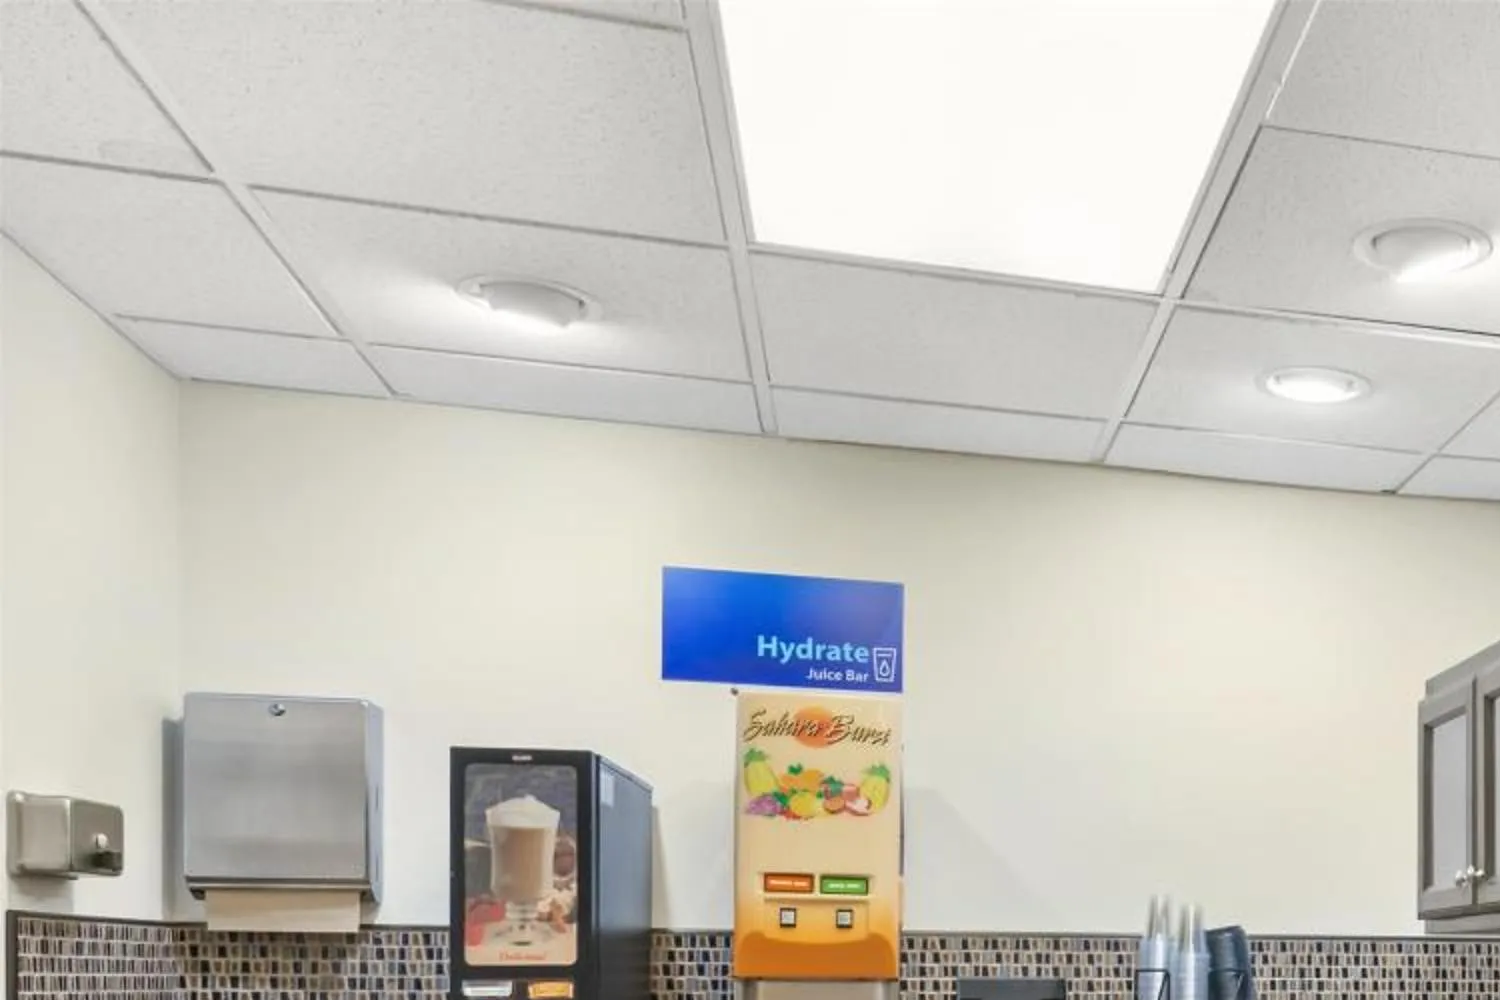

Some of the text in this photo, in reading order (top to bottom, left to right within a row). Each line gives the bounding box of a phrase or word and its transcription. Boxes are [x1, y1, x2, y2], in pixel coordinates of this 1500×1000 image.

[757, 634, 869, 664] Hydrate
[805, 667, 868, 682] Juice Bar
